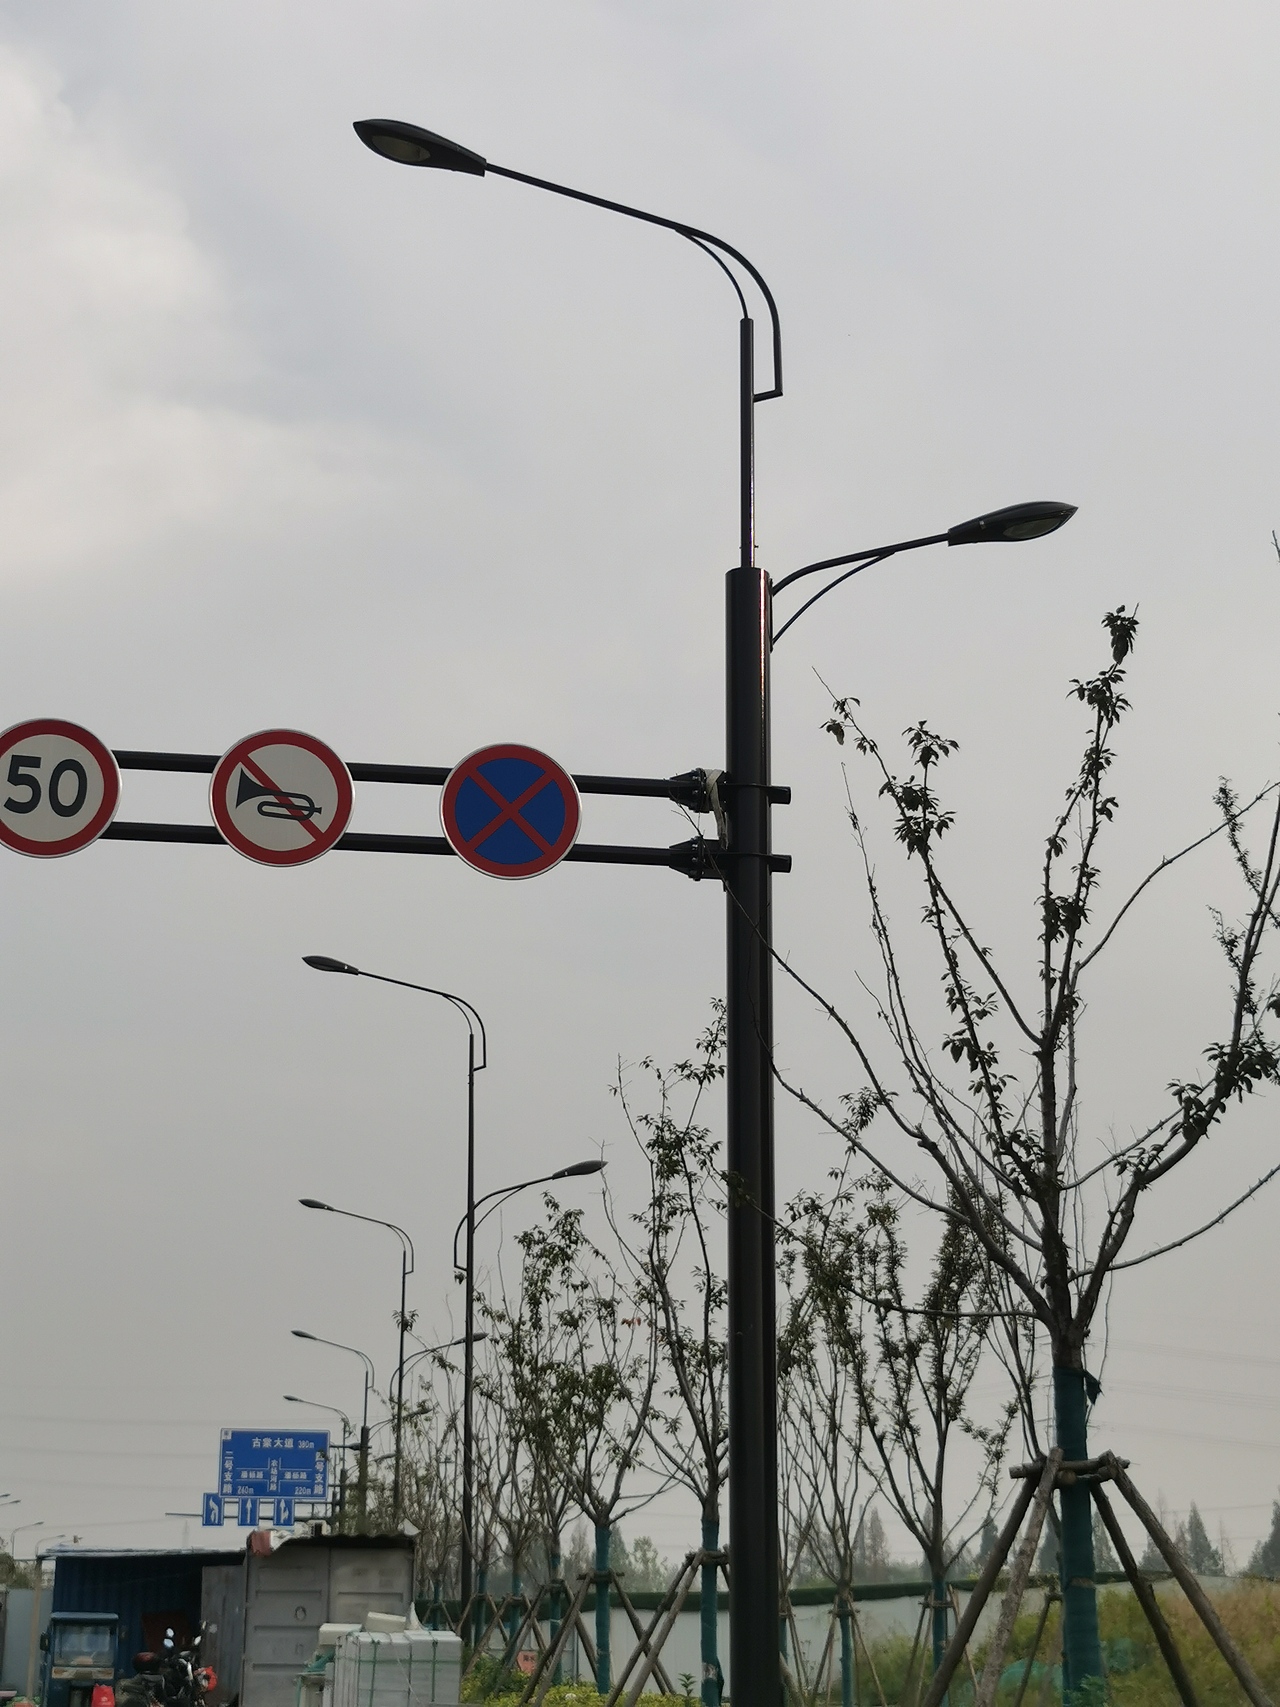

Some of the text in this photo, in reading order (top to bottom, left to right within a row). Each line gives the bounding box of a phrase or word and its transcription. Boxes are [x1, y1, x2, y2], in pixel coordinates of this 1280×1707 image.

[4, 755, 87, 817] 50
[223, 1451, 234, 1494] 二号支路
[294, 1486, 312, 1495] 220m
